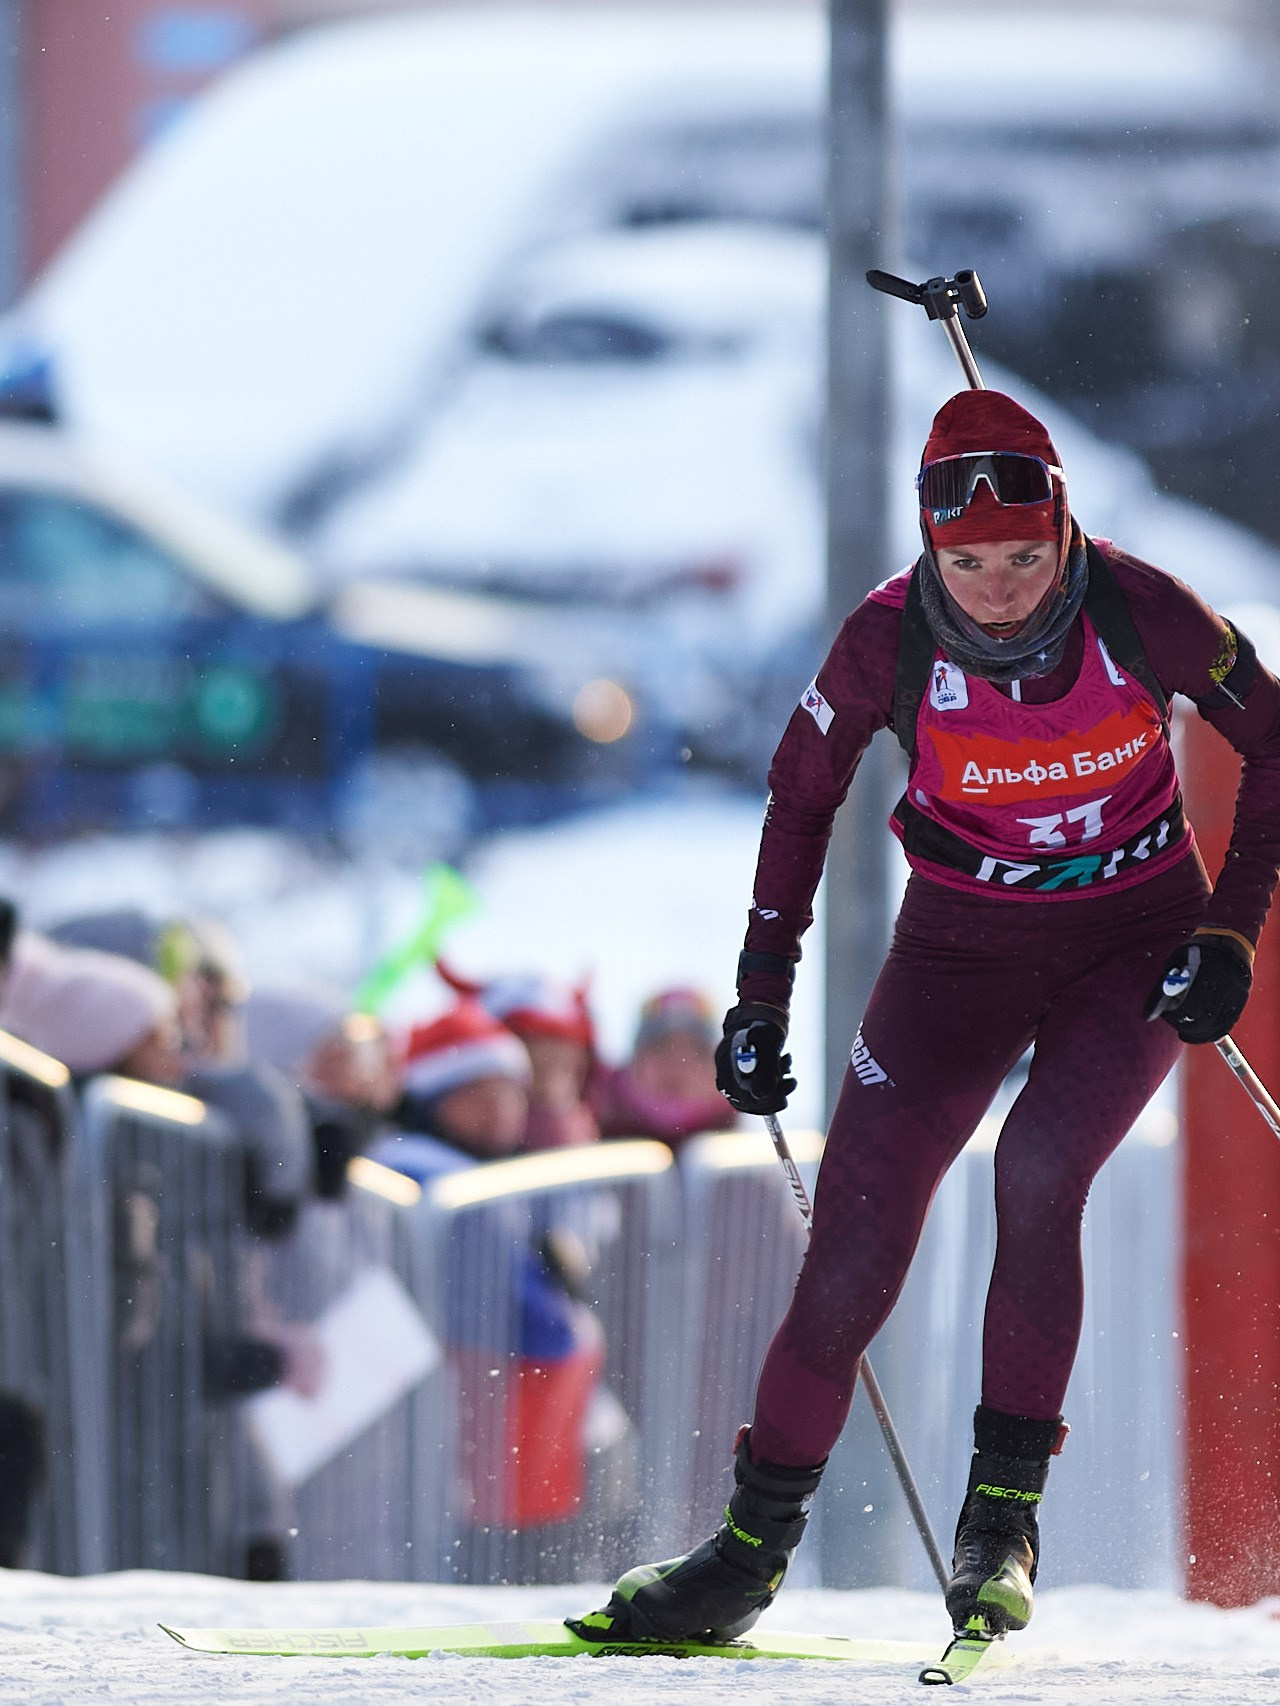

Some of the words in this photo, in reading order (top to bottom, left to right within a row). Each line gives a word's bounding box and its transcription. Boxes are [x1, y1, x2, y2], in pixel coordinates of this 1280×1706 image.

[961, 759, 1069, 786] Альфа
[1072, 732, 1147, 777] Банк
[1016, 794, 1113, 851] 37
[975, 1483, 1043, 1503] FISCHER
[227, 1631, 370, 1649] FISCHER
